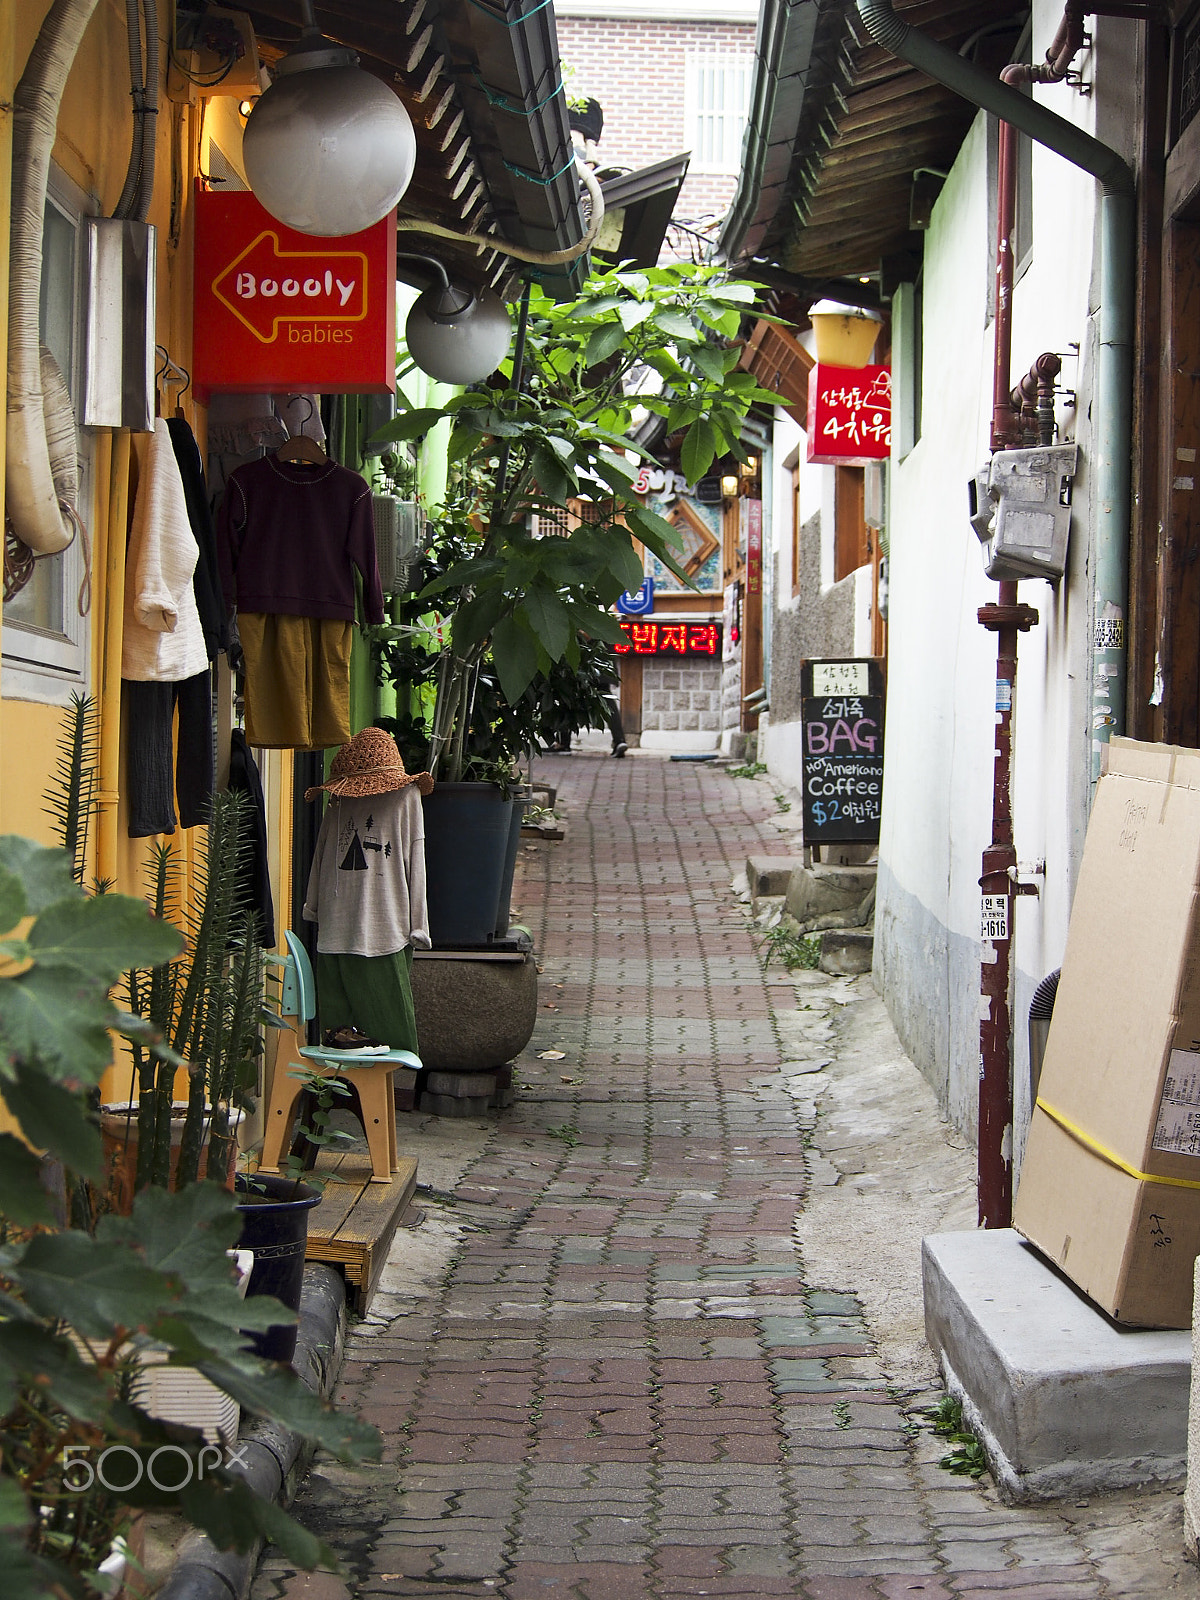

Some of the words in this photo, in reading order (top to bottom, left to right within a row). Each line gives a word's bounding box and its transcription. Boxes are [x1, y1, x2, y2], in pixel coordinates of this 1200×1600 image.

[235, 269, 356, 306] Boooly
[287, 323, 353, 344] babies
[821, 387, 863, 411] 삼청동
[823, 665, 859, 679] 삼청동
[823, 684, 859, 695] 4차원
[822, 698, 864, 718] 소가죽
[806, 718, 878, 755] BAG
[806, 757, 827, 775] HOT
[823, 763, 883, 777] Americano
[808, 777, 880, 796] Coffee
[811, 799, 842, 827] $2
[842, 799, 880, 824] 이천원
[981, 920, 1006, 937] -1616
